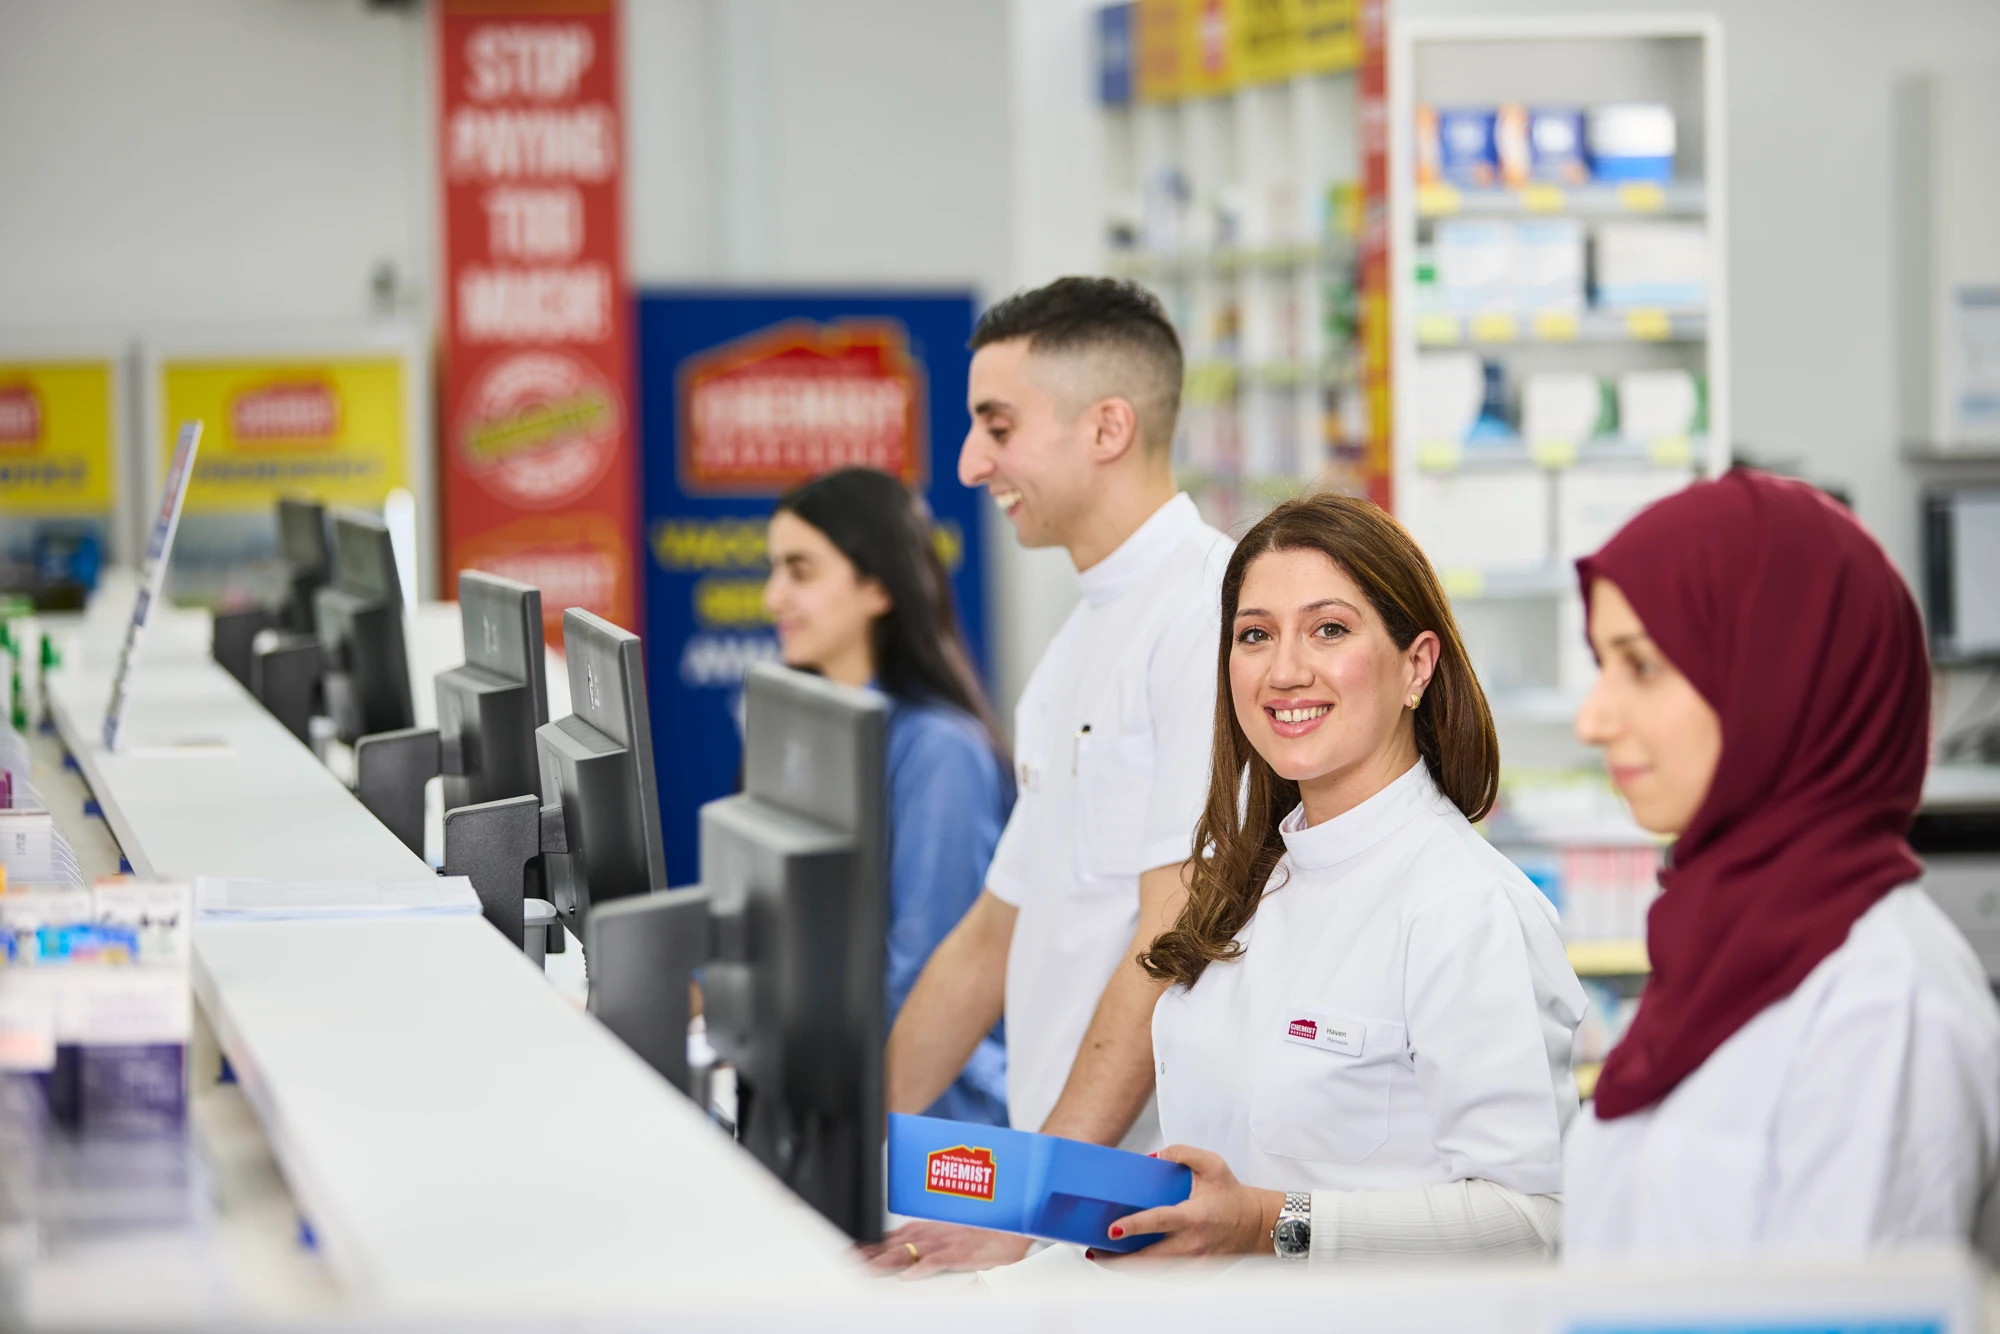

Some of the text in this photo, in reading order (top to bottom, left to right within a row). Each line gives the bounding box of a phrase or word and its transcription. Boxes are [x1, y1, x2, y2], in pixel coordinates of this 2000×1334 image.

[466, 25, 593, 99] STOP
[449, 107, 615, 181] PAYING
[483, 187, 582, 259] TOO
[1290, 1023, 1316, 1035] CHEMIST
[1326, 1027, 1347, 1038] Haven
[931, 1159, 992, 1184] CHEMIST
[931, 1176, 989, 1194] WAREHOUSE
